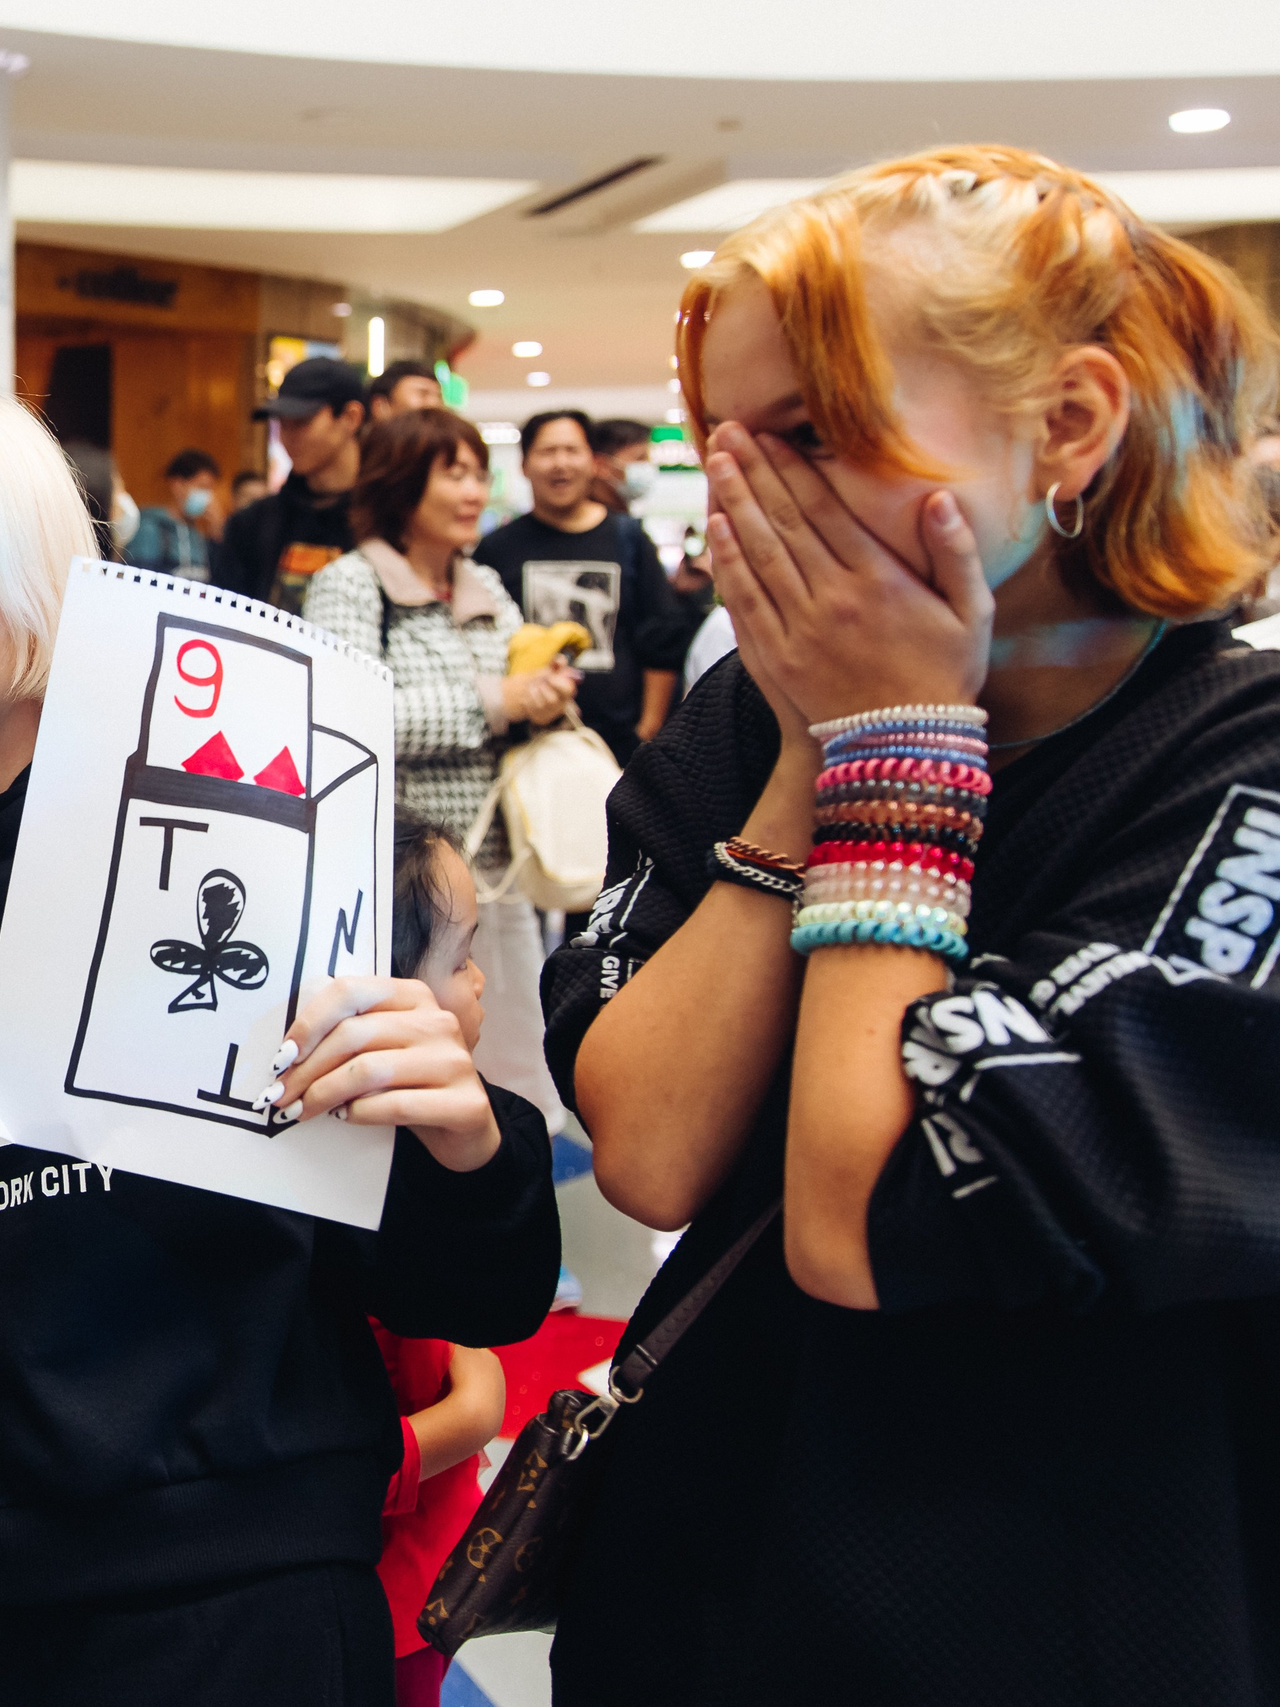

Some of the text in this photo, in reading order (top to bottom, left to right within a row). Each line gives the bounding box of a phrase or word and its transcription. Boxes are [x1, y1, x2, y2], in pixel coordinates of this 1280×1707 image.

[173, 639, 224, 719] 9
[139, 816, 209, 891] T
[41, 1162, 114, 1197] CITY
